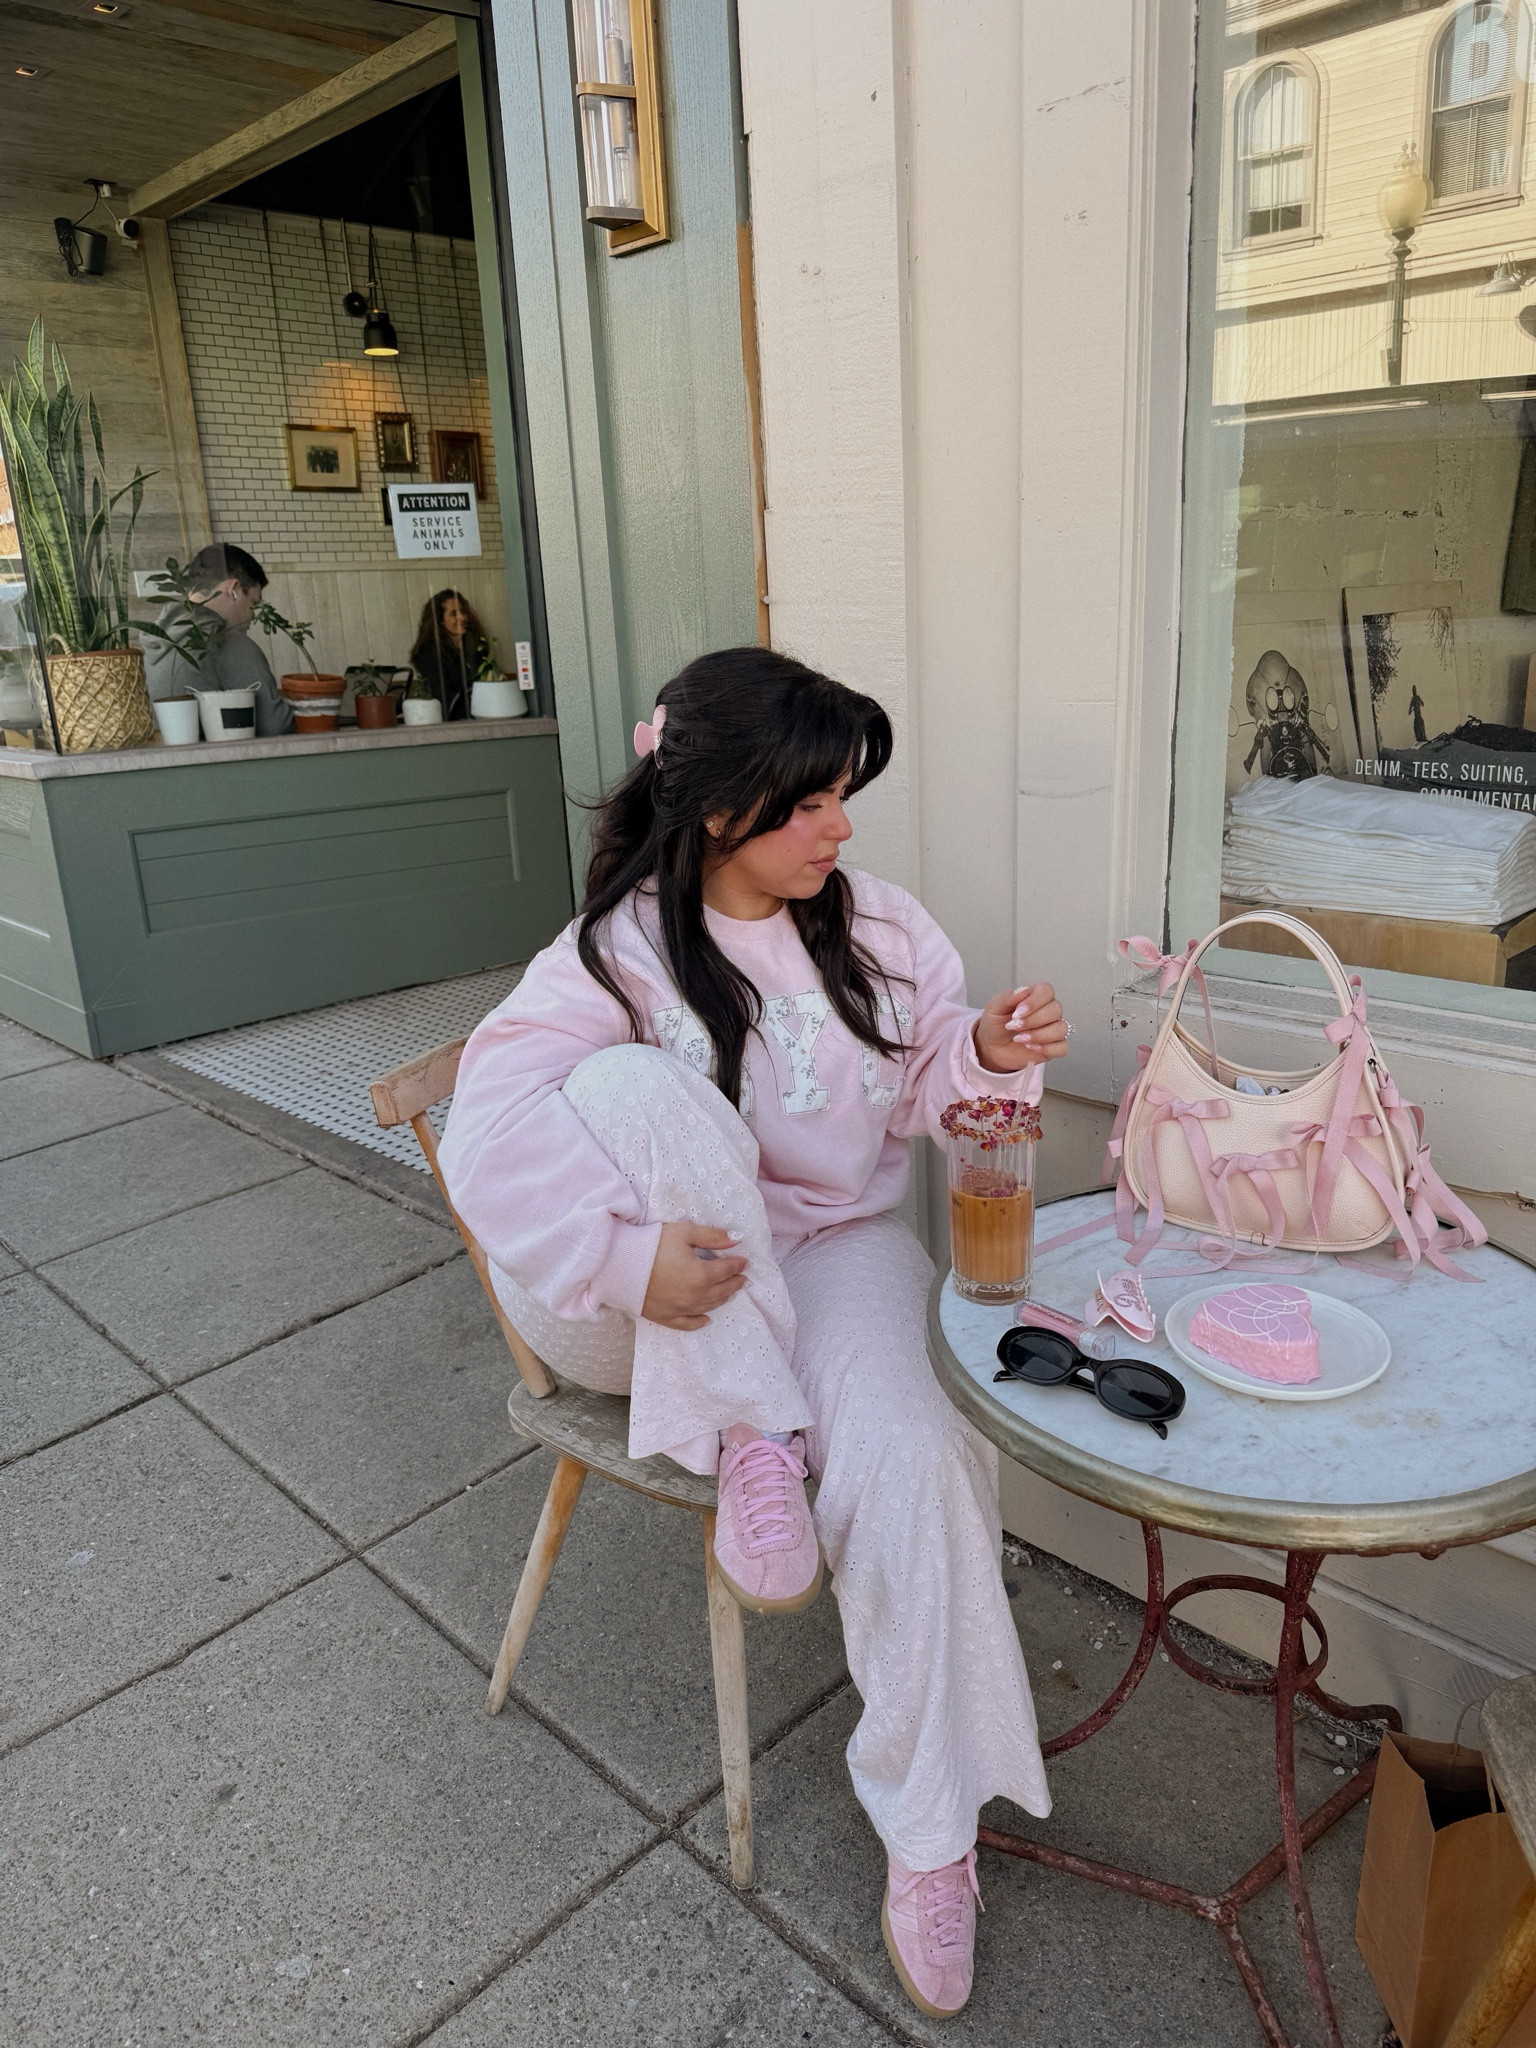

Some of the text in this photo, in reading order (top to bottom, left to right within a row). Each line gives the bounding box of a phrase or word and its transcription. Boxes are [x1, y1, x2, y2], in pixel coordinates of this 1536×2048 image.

[402, 495, 467, 509] ATTENTION
[412, 516, 462, 527] SERVICE
[412, 528, 465, 539] ANIMALS
[424, 540, 455, 550] ONLY
[1355, 759, 1528, 786] DENIM, TEES, SUITING,
